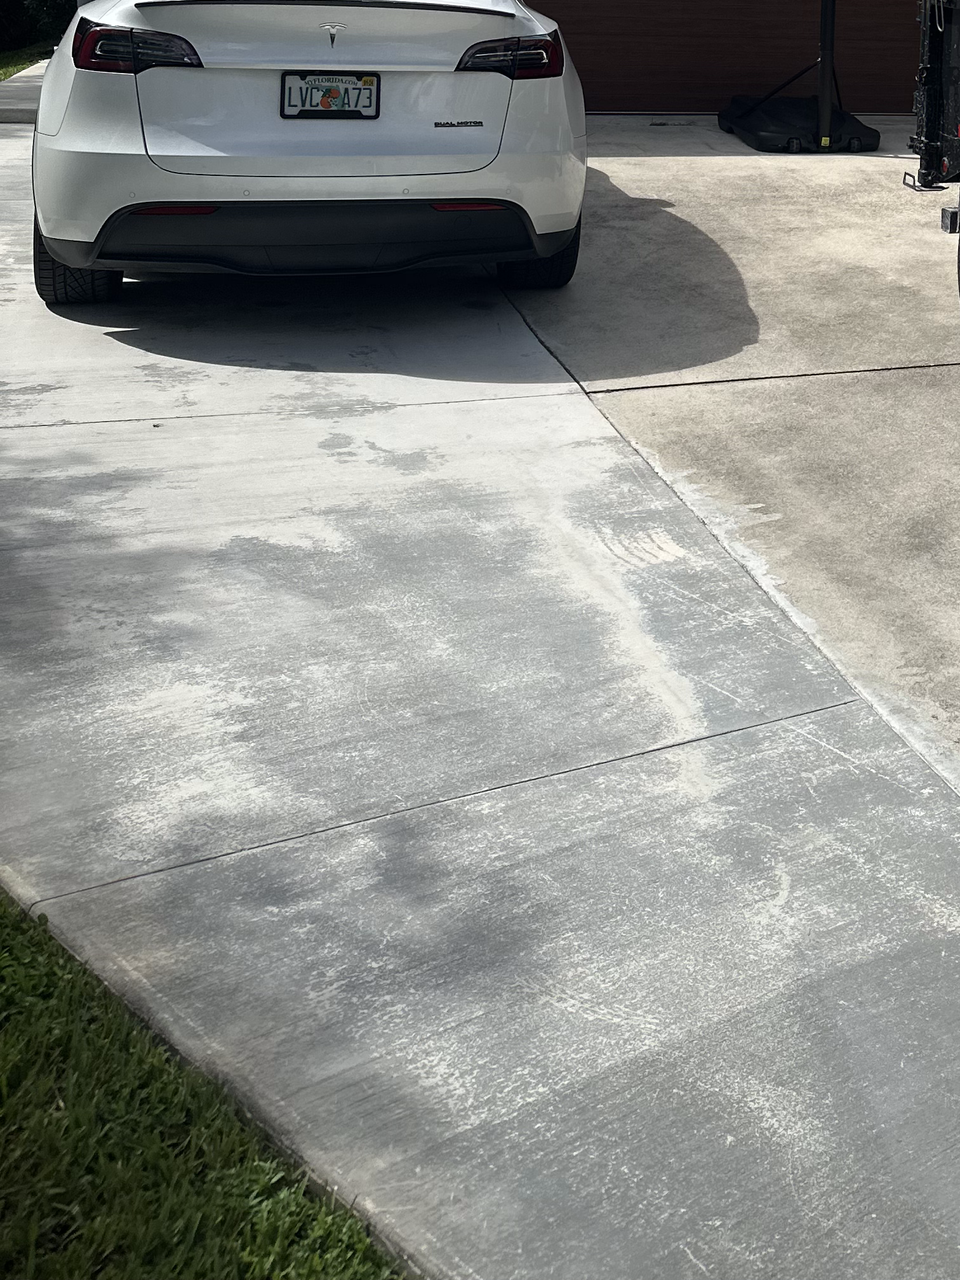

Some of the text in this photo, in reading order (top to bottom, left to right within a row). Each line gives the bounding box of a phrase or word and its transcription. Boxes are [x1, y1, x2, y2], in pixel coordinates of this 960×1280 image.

[304, 77, 358, 86] MYFLORIDA.COM
[288, 87, 373, 108] LVC A73
